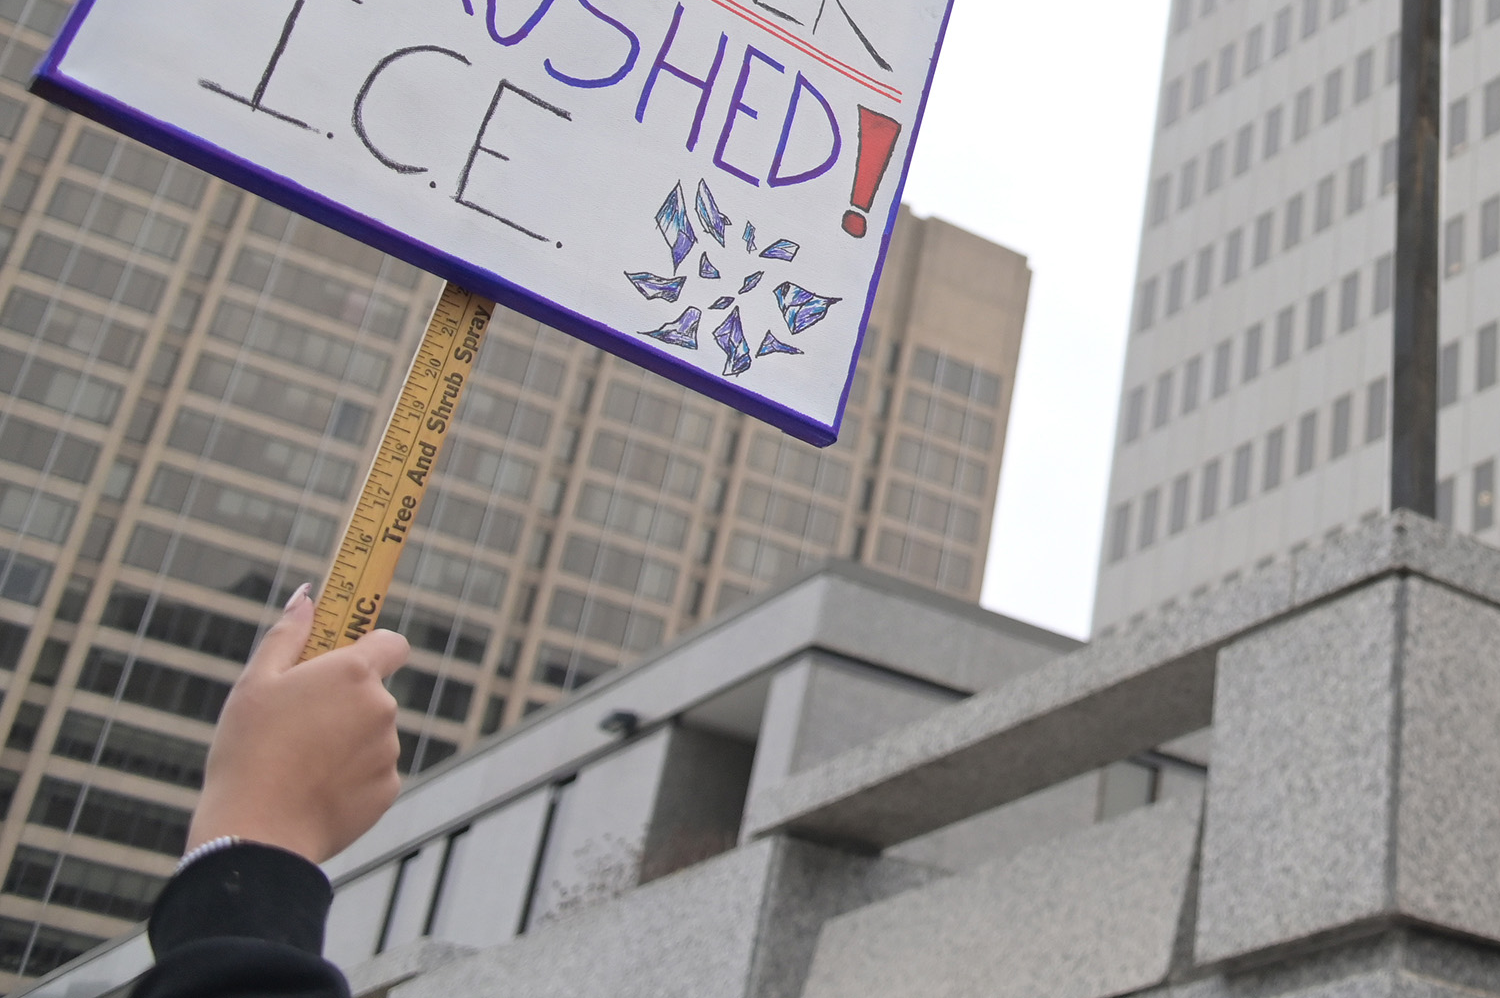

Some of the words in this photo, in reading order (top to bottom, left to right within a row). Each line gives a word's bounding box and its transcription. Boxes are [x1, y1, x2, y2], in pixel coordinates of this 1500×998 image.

[441, 317, 459, 338] 21
[425, 358, 442, 380] 20
[408, 399, 425, 422] 19
[382, 495, 417, 544] Tree
[407, 441, 437, 487] And
[426, 371, 464, 435] Shrub
[454, 304, 491, 364] Spray
[391, 442, 409, 465] 18
[374, 486, 391, 509] 17
[355, 533, 373, 555] 16
[336, 580, 355, 602] 15
[344, 593, 381, 641] INC.
[318, 628, 336, 650] 14
